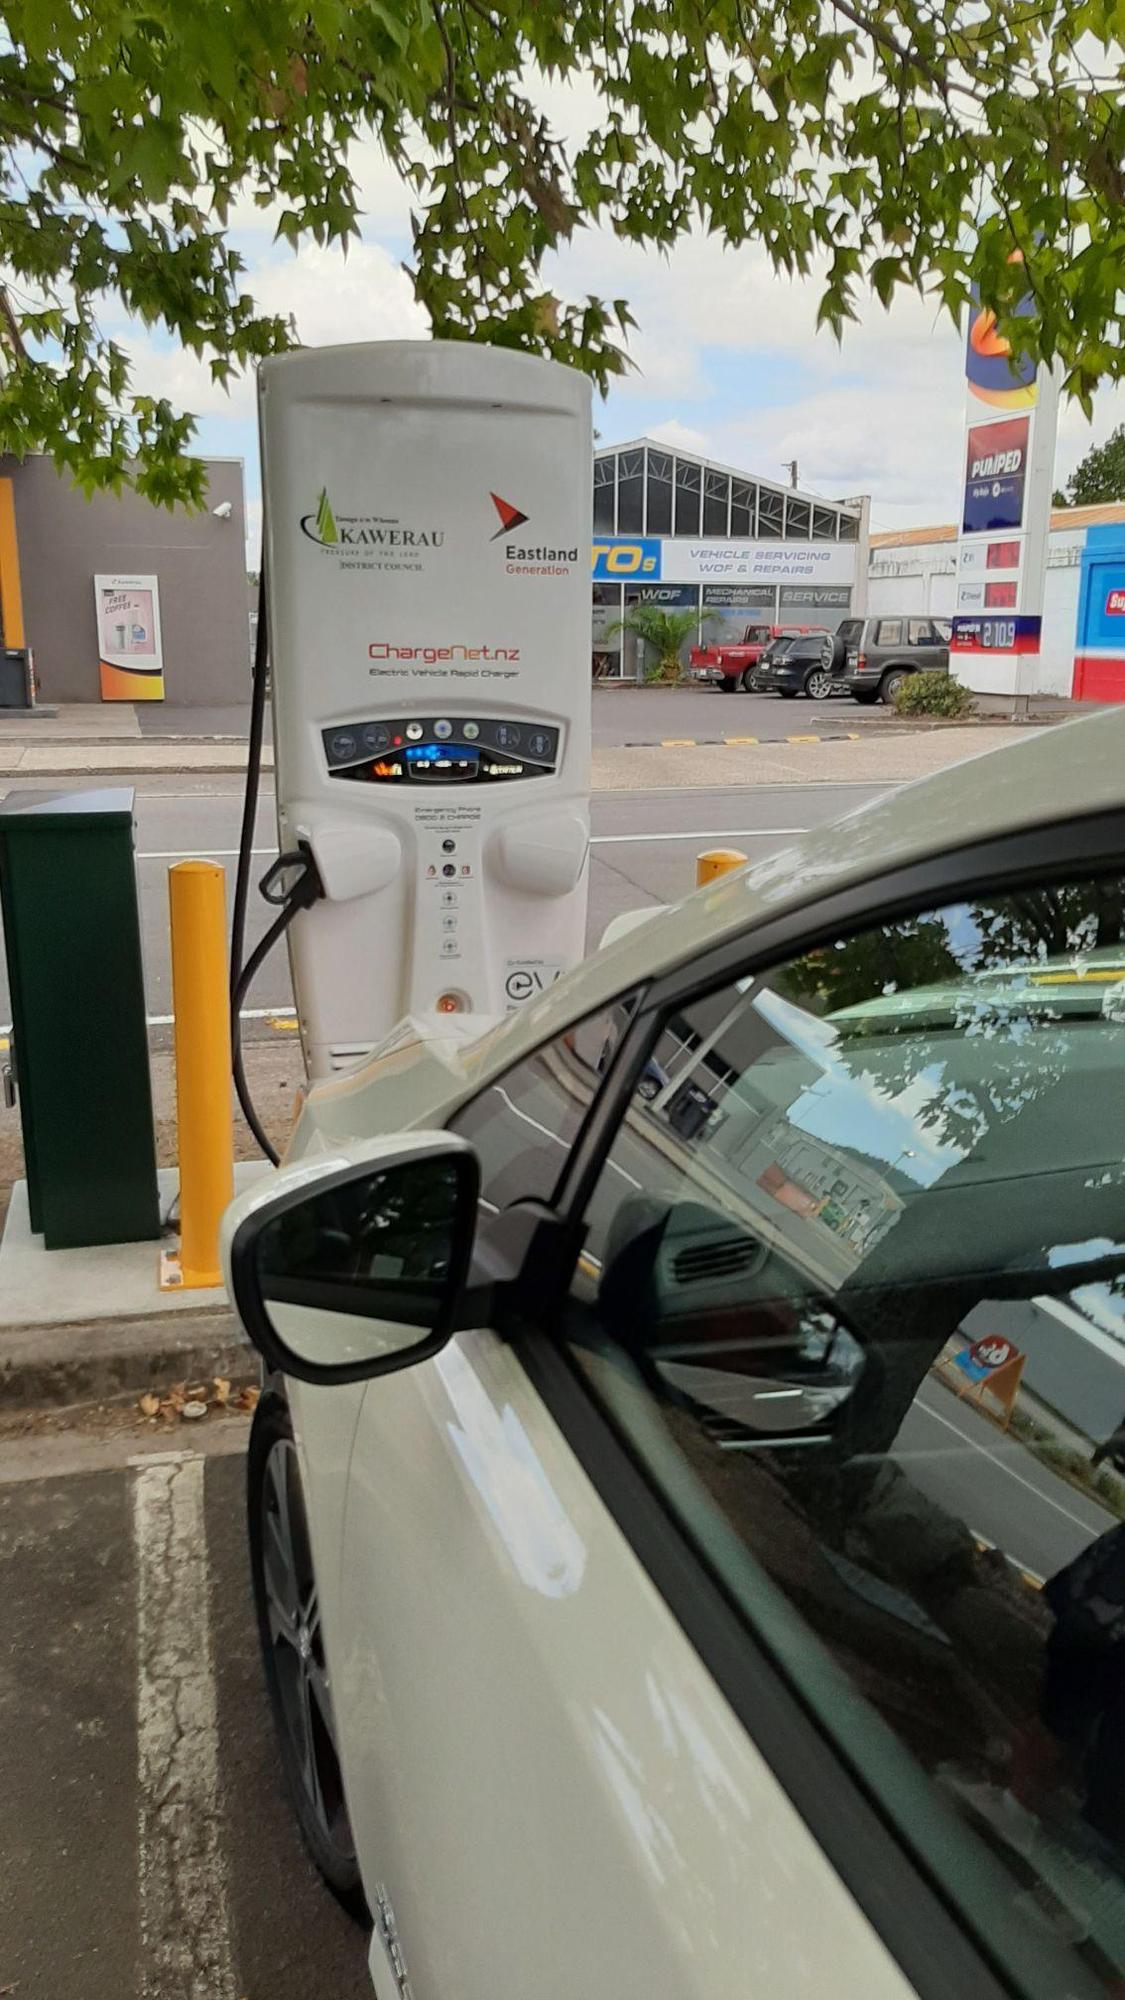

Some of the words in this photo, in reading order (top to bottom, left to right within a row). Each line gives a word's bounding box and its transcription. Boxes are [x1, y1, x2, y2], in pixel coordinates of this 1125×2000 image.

[971, 449, 1022, 478] PUMPED
[340, 527, 445, 547] KAWERAU
[506, 545, 578, 562] Eastland
[690, 549, 750, 559] VEHICLE
[755, 551, 832, 561] SERVICING
[339, 560, 382, 570] DISTRICT
[384, 562, 423, 571] COUNCIL
[506, 563, 570, 576] Generation
[699, 563, 734, 573] WOF
[737, 564, 747, 572] &
[753, 564, 815, 574] REPAIRS
[641, 588, 682, 600] WOF
[705, 588, 774, 597] MECHANICAL
[782, 590, 849, 603] SERVICE
[705, 596, 749, 604] REPAIRS
[368, 643, 520, 664] ChargeNet.nz
[369, 668, 409, 676] Electric
[412, 669, 448, 677] Vehicle
[451, 669, 480, 678] Rapid
[481, 670, 520, 678] Charger
